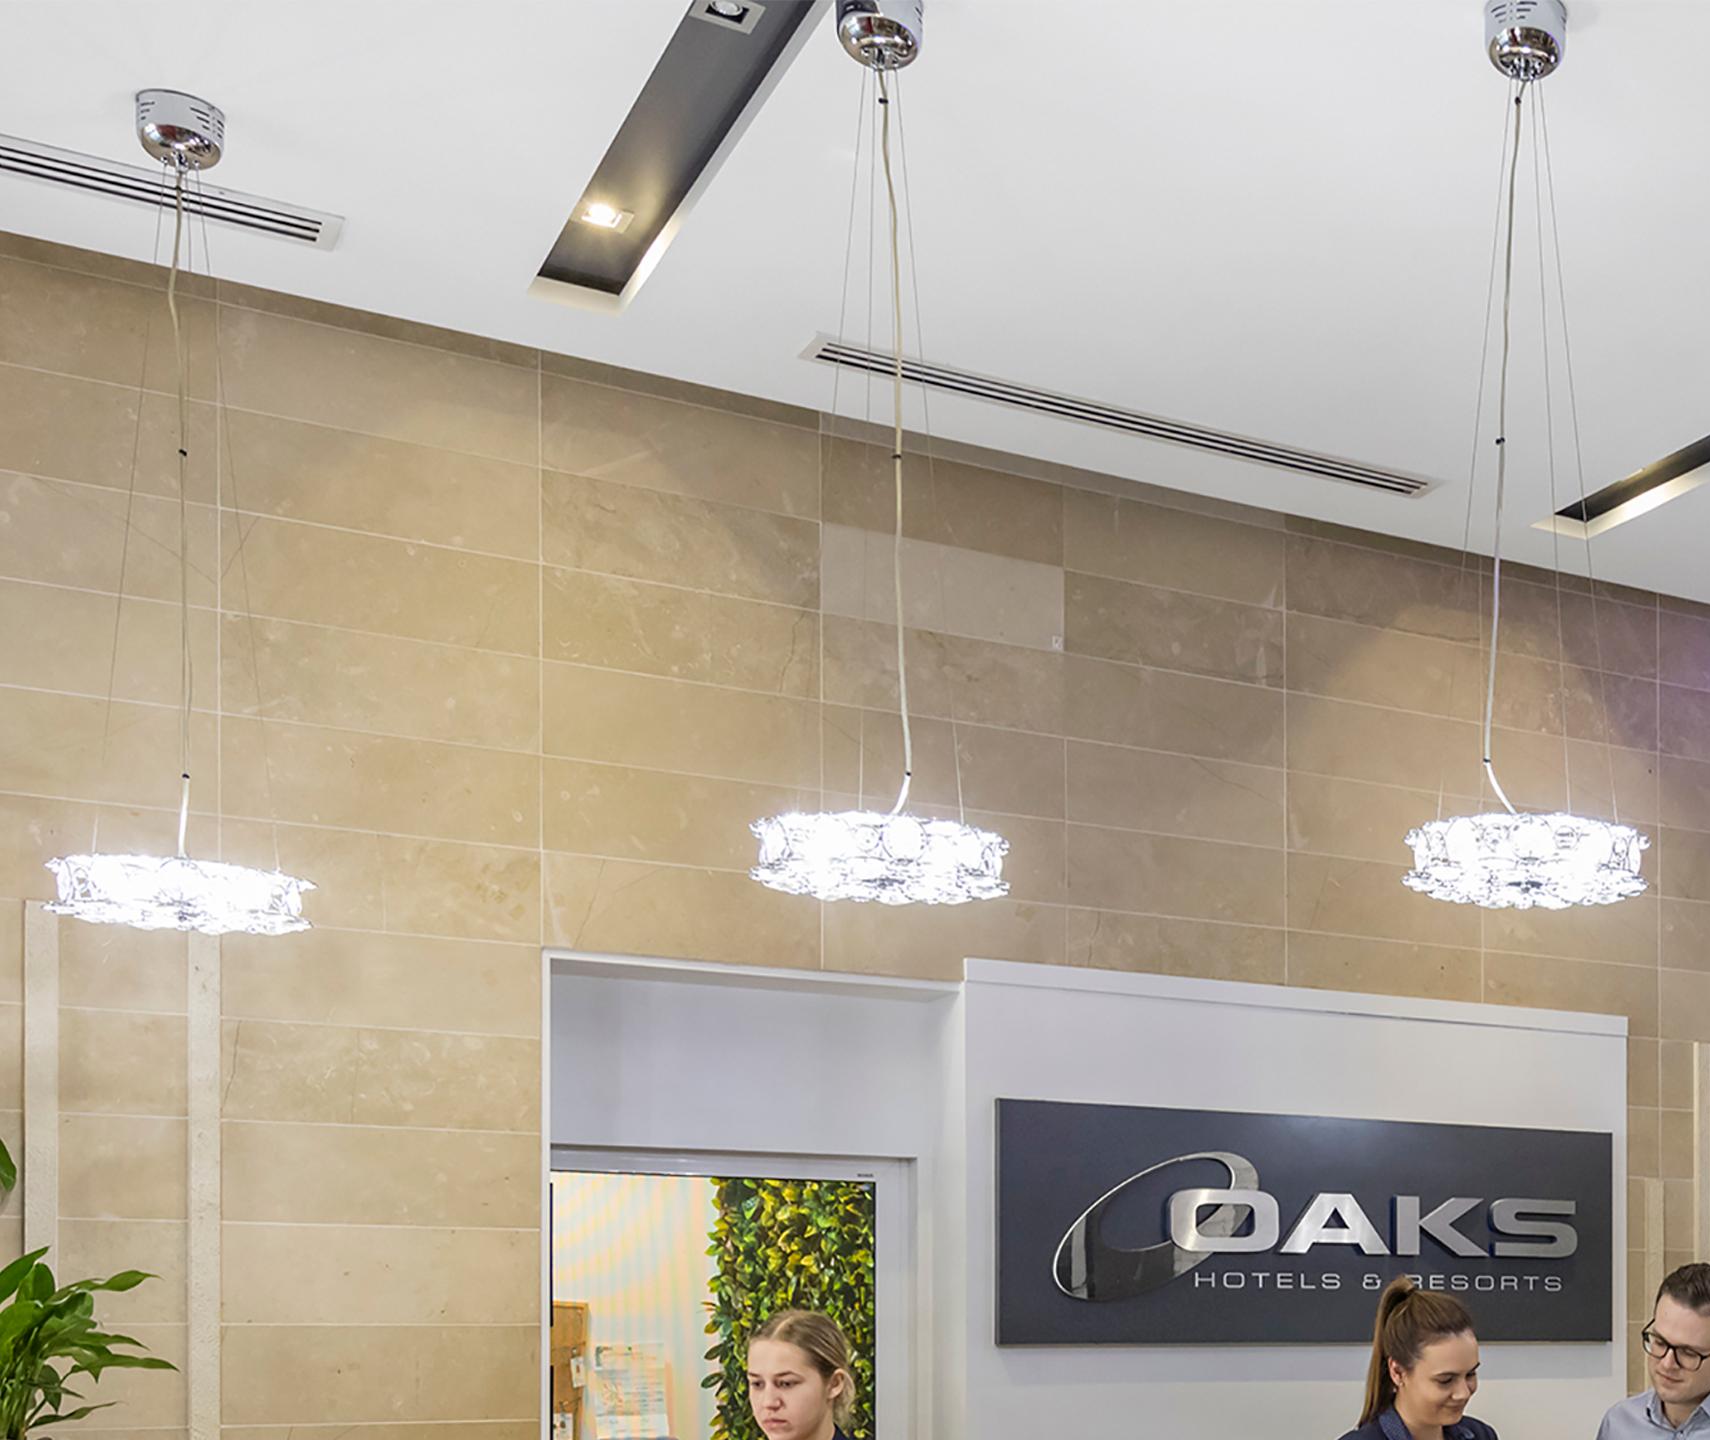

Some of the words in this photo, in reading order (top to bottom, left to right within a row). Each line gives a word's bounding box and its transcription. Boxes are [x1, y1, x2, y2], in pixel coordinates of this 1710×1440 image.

[1169, 1189, 1578, 1258] OAKS
[1194, 1271, 1341, 1289] HOTELS
[1362, 1273, 1382, 1290] &
